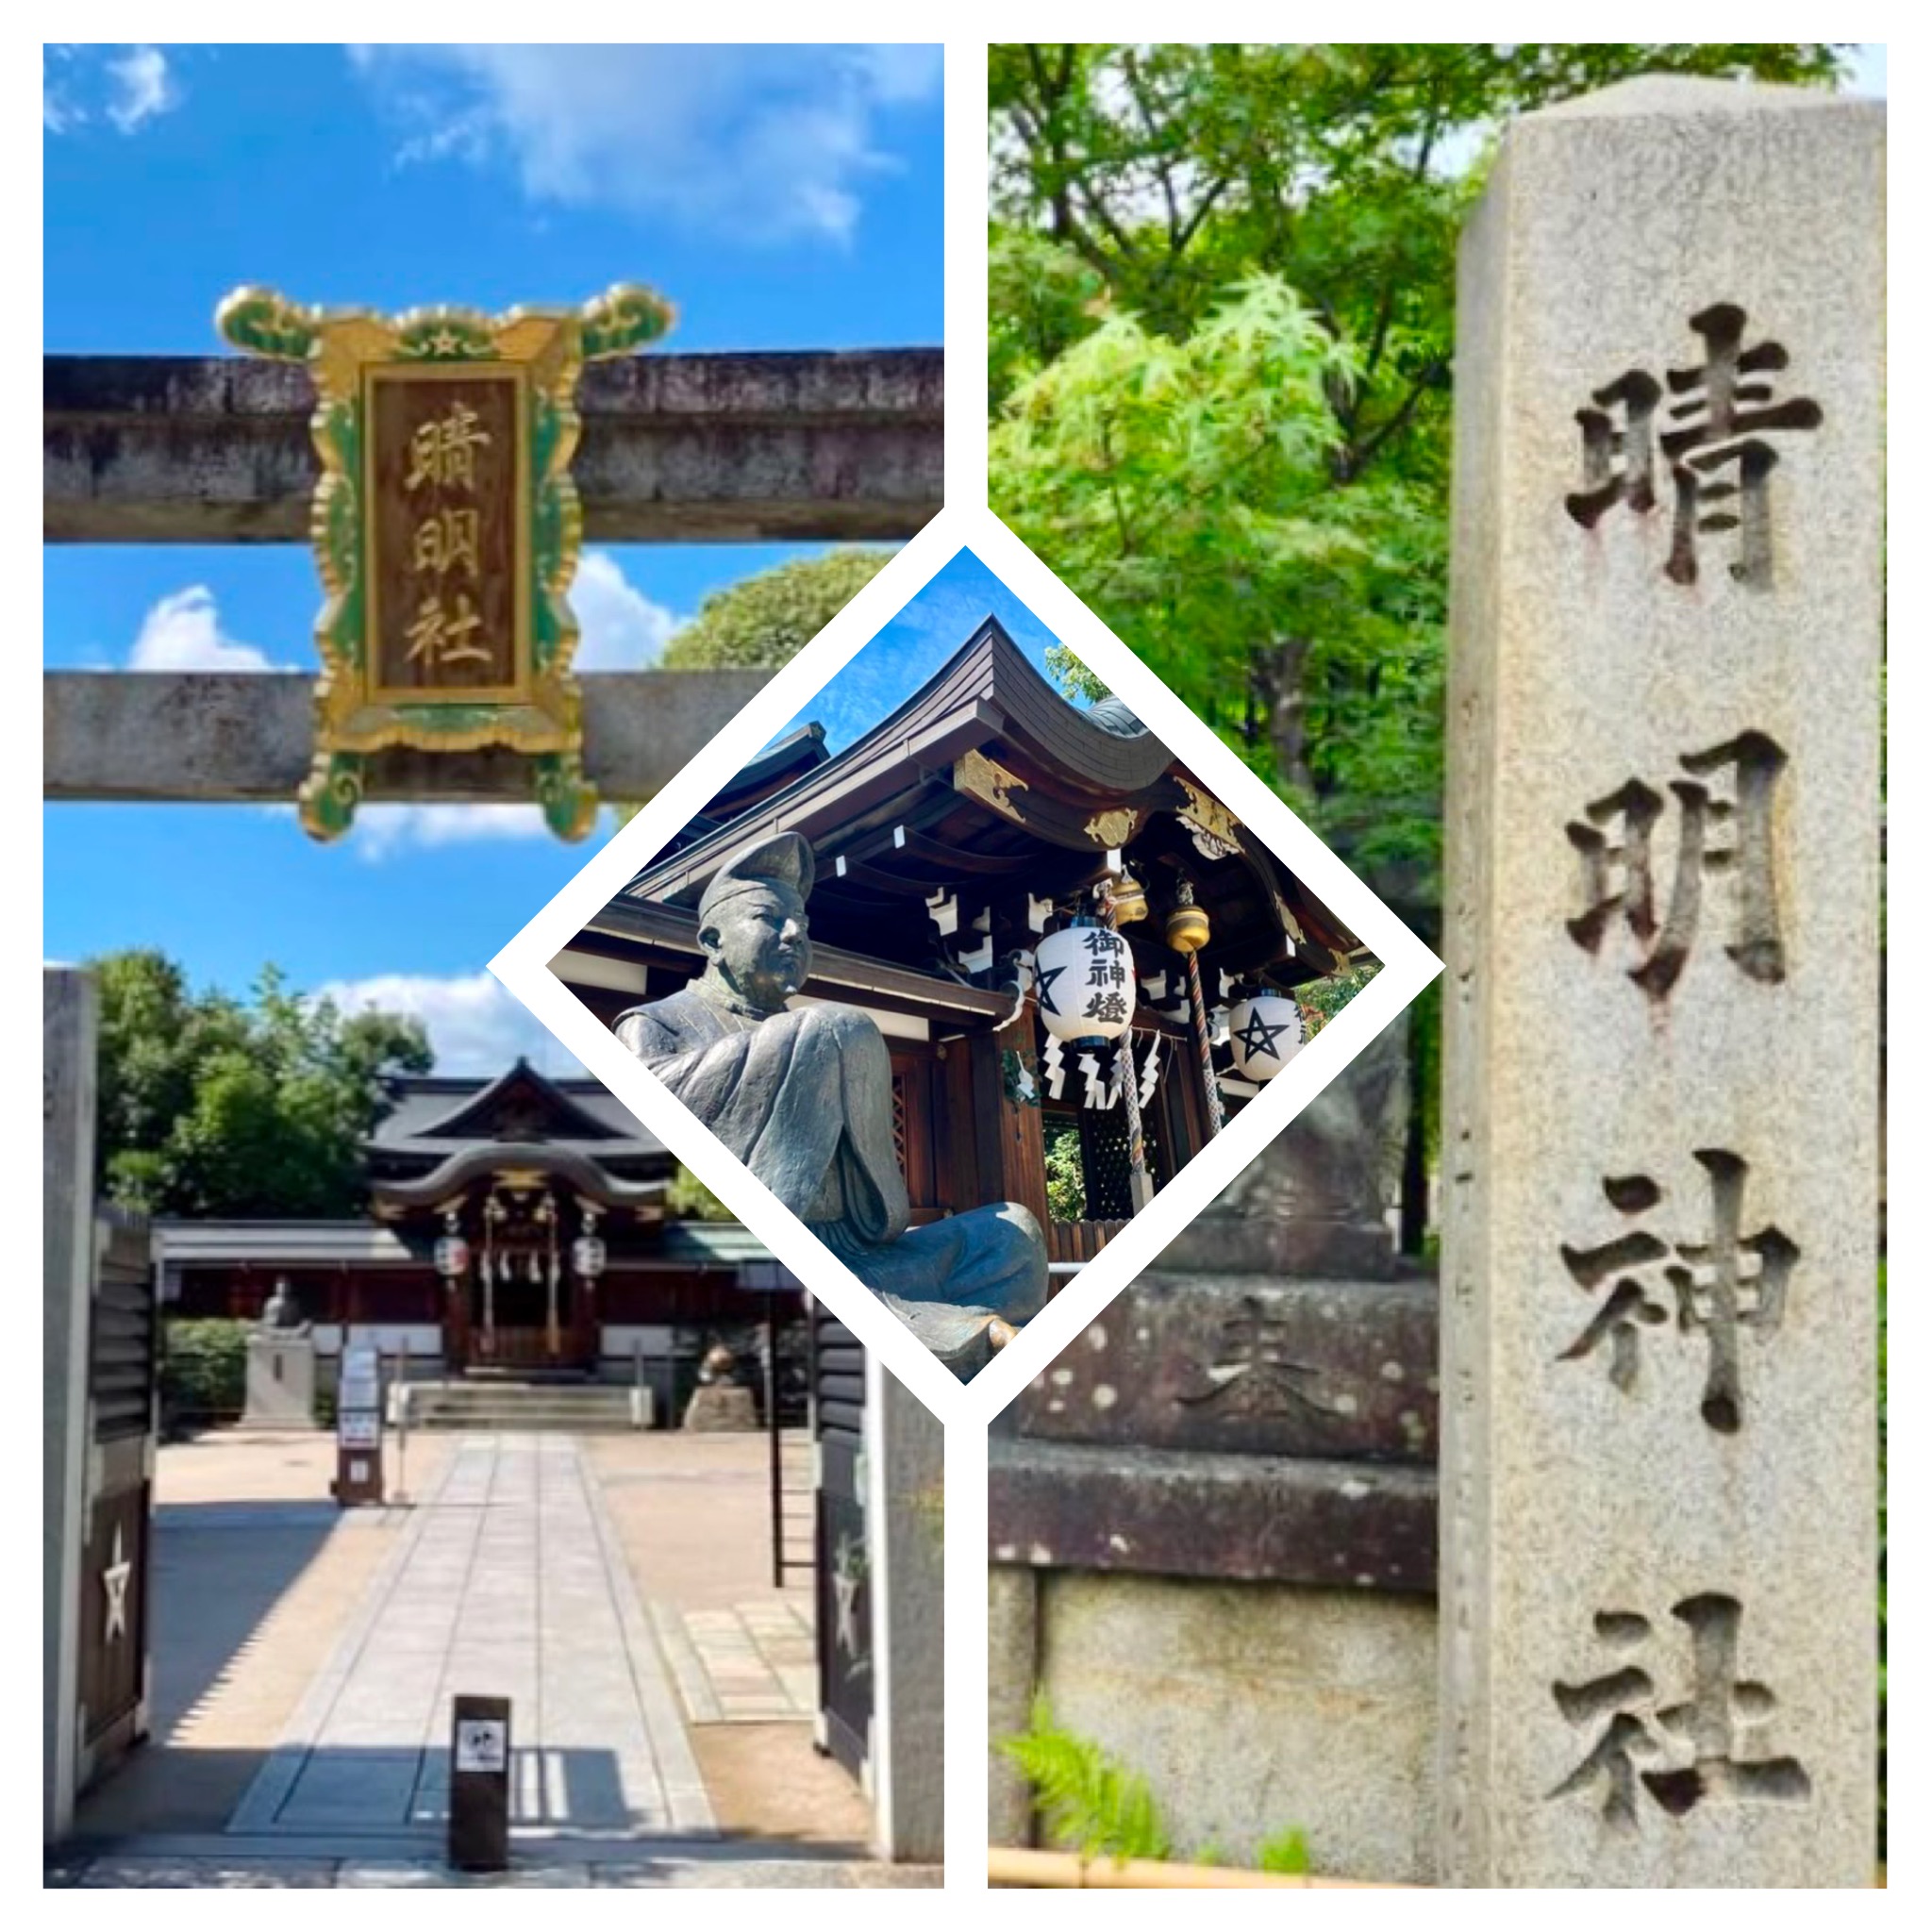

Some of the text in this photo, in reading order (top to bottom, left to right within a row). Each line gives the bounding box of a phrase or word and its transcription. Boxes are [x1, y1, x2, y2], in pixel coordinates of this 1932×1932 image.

[404, 400, 492, 666] 晴明社
[1081, 929, 1127, 1024] 御神燈
[1544, 302, 1823, 1828] 晴明神社
